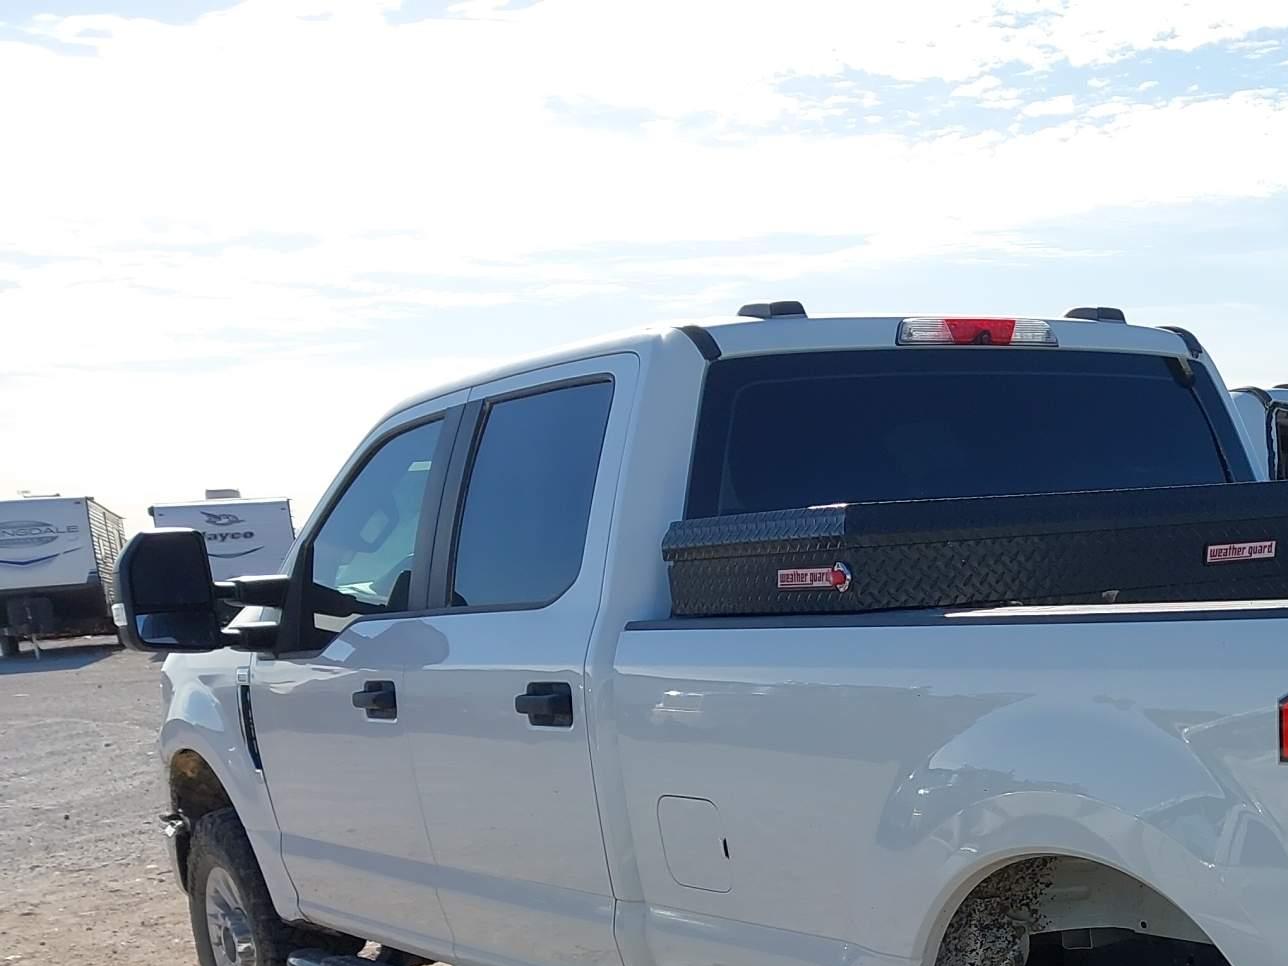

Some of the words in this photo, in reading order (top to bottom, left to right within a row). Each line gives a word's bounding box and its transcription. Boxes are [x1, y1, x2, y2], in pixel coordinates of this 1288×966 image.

[1209, 544, 1246, 558] weather
[1247, 542, 1273, 557] guard
[779, 571, 808, 584] weather
